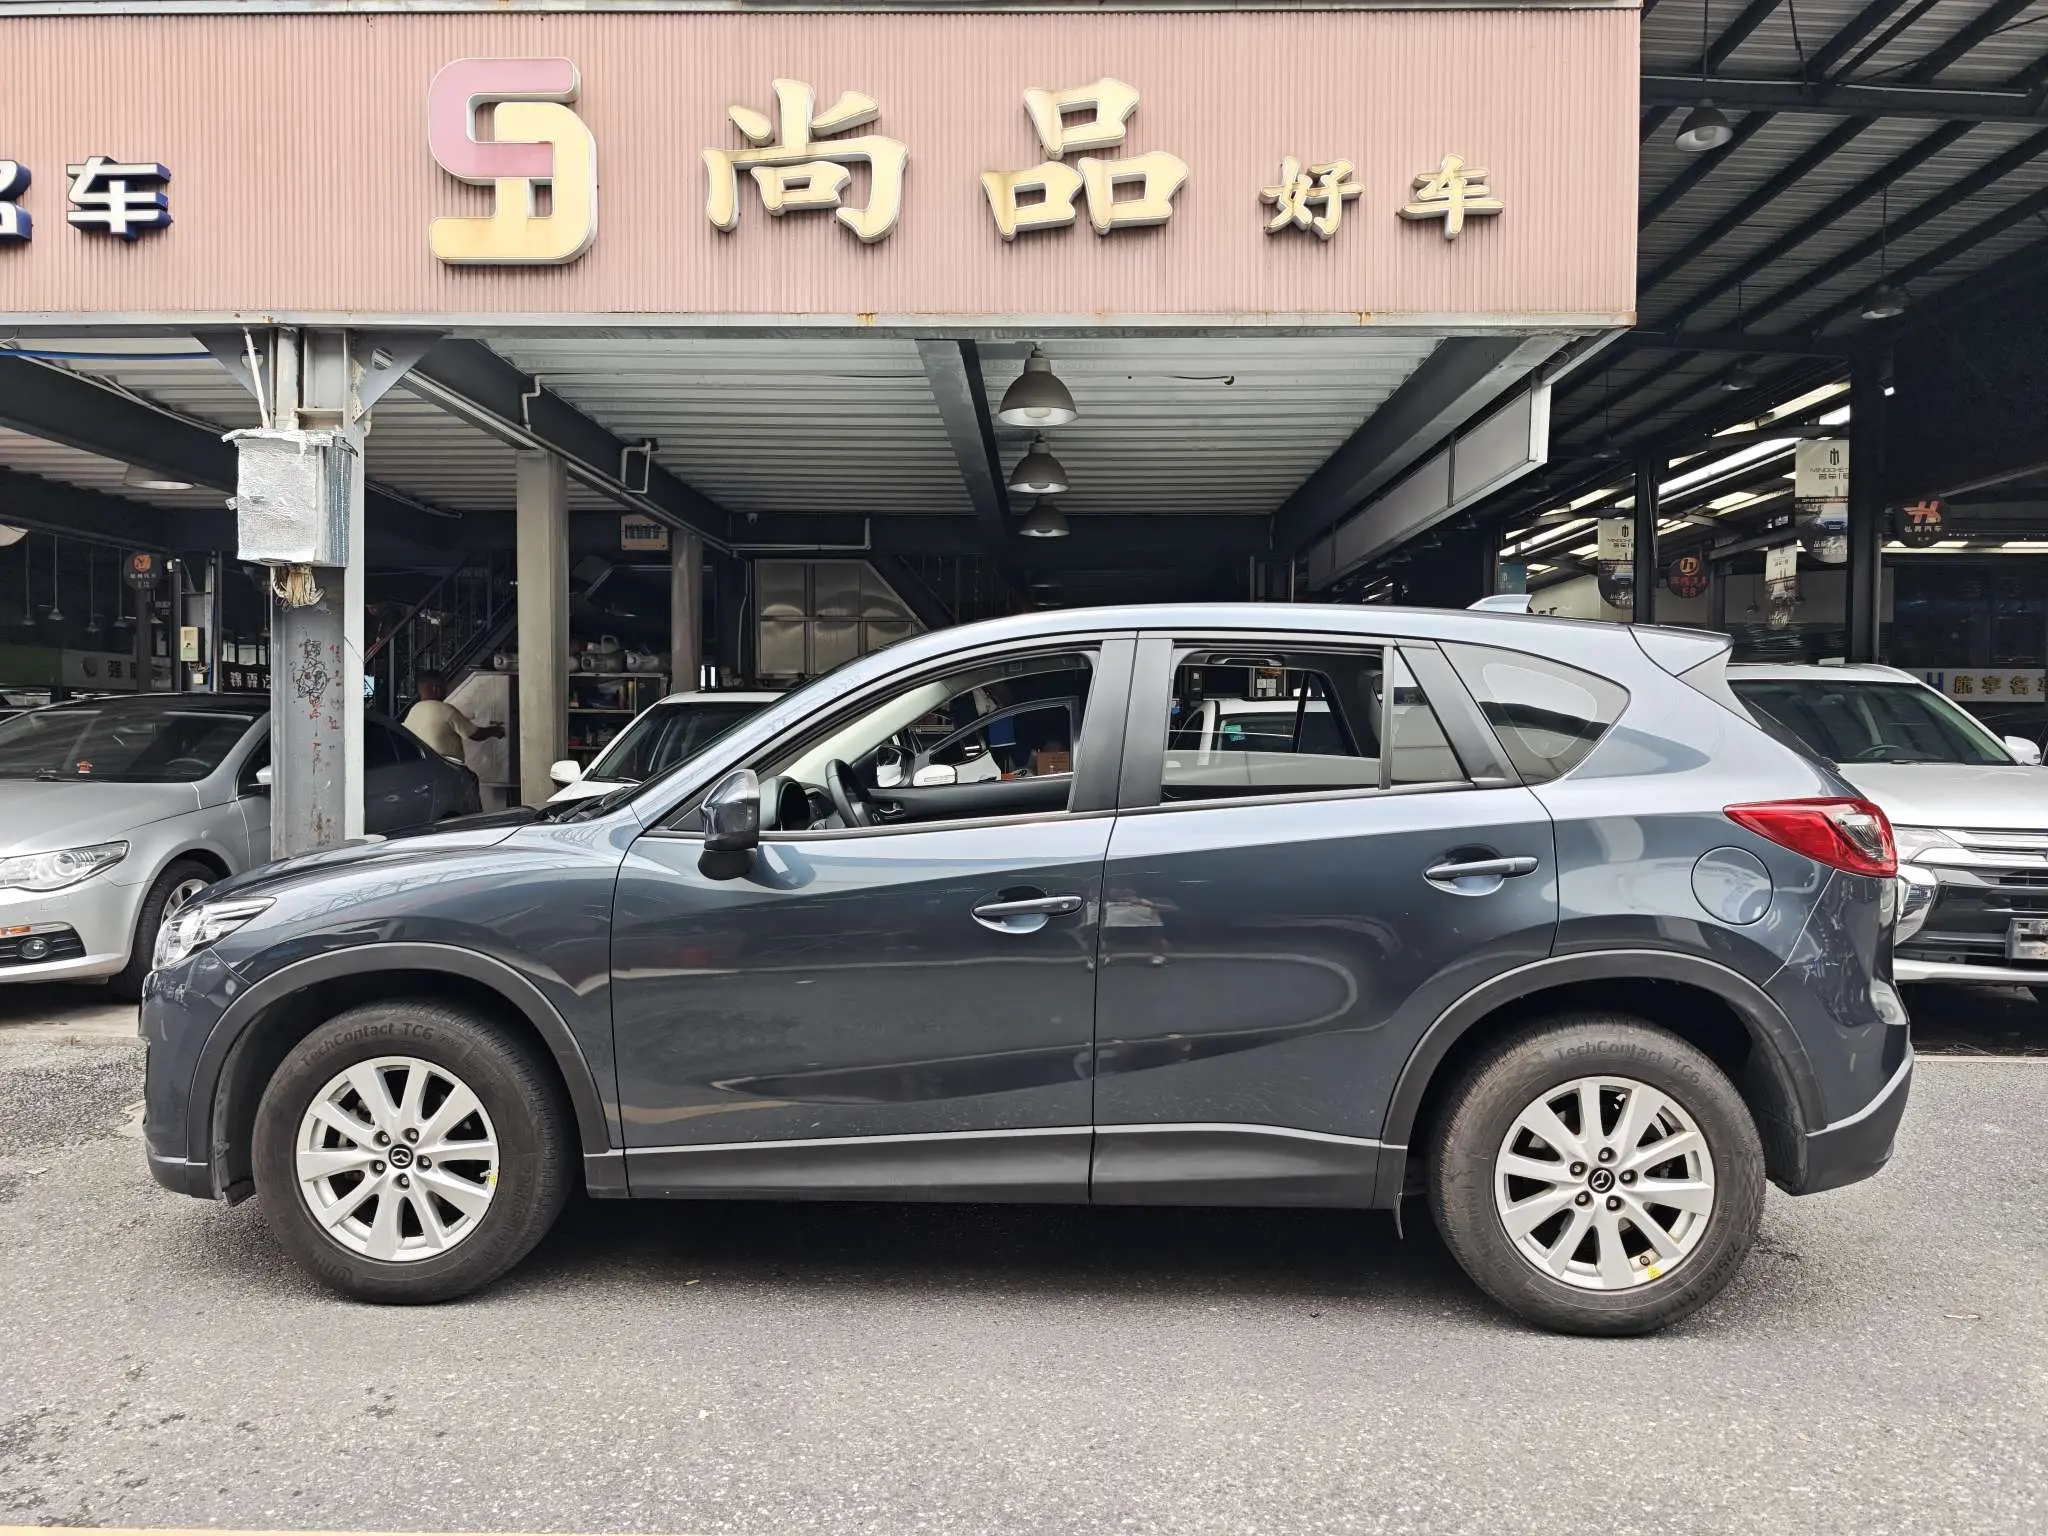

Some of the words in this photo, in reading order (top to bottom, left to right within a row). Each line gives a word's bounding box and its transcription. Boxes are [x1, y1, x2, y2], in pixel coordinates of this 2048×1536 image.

[702, 77, 1190, 244] 尚品
[1259, 154, 1505, 241] 好车
[300, 1022, 395, 1067] TechContact
[402, 1022, 435, 1041] TC6
[1553, 1040, 1665, 1062] TechContact
[1671, 1056, 1702, 1086] TC6
